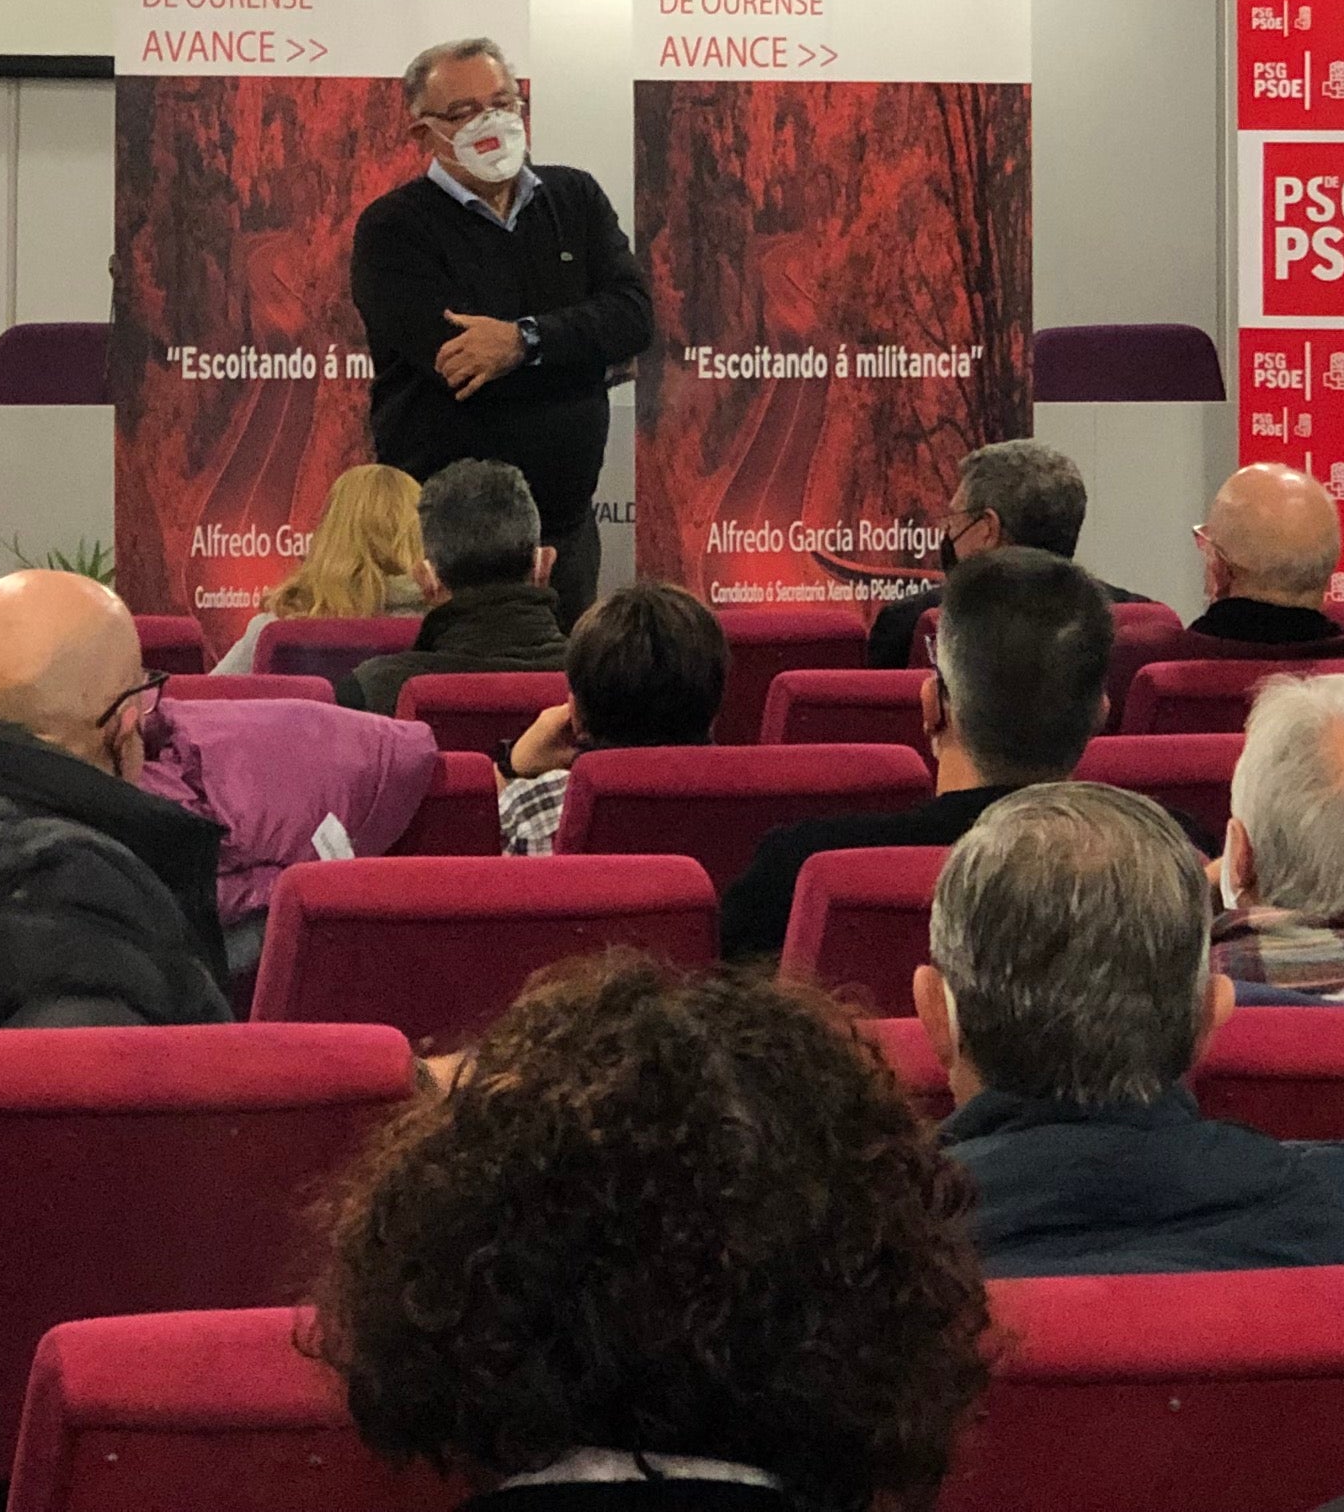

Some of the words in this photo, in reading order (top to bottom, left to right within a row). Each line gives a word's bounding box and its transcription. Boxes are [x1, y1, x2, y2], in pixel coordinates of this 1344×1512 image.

[142, 30, 275, 63] AVANCE
[659, 36, 787, 68] AVANCE
[1254, 62, 1287, 79] PSG
[1254, 79, 1302, 99] PSOE
[1254, 352, 1287, 369] PSG
[1254, 369, 1302, 389] PSOE
[191, 524, 271, 557] Alfredo
[707, 520, 783, 554] Alfredo
[789, 520, 853, 552] García
[711, 581, 763, 603] Candidato
[827, 582, 853, 601] Xeral
[855, 582, 869, 600] do
[871, 580, 904, 601] PSdeG
